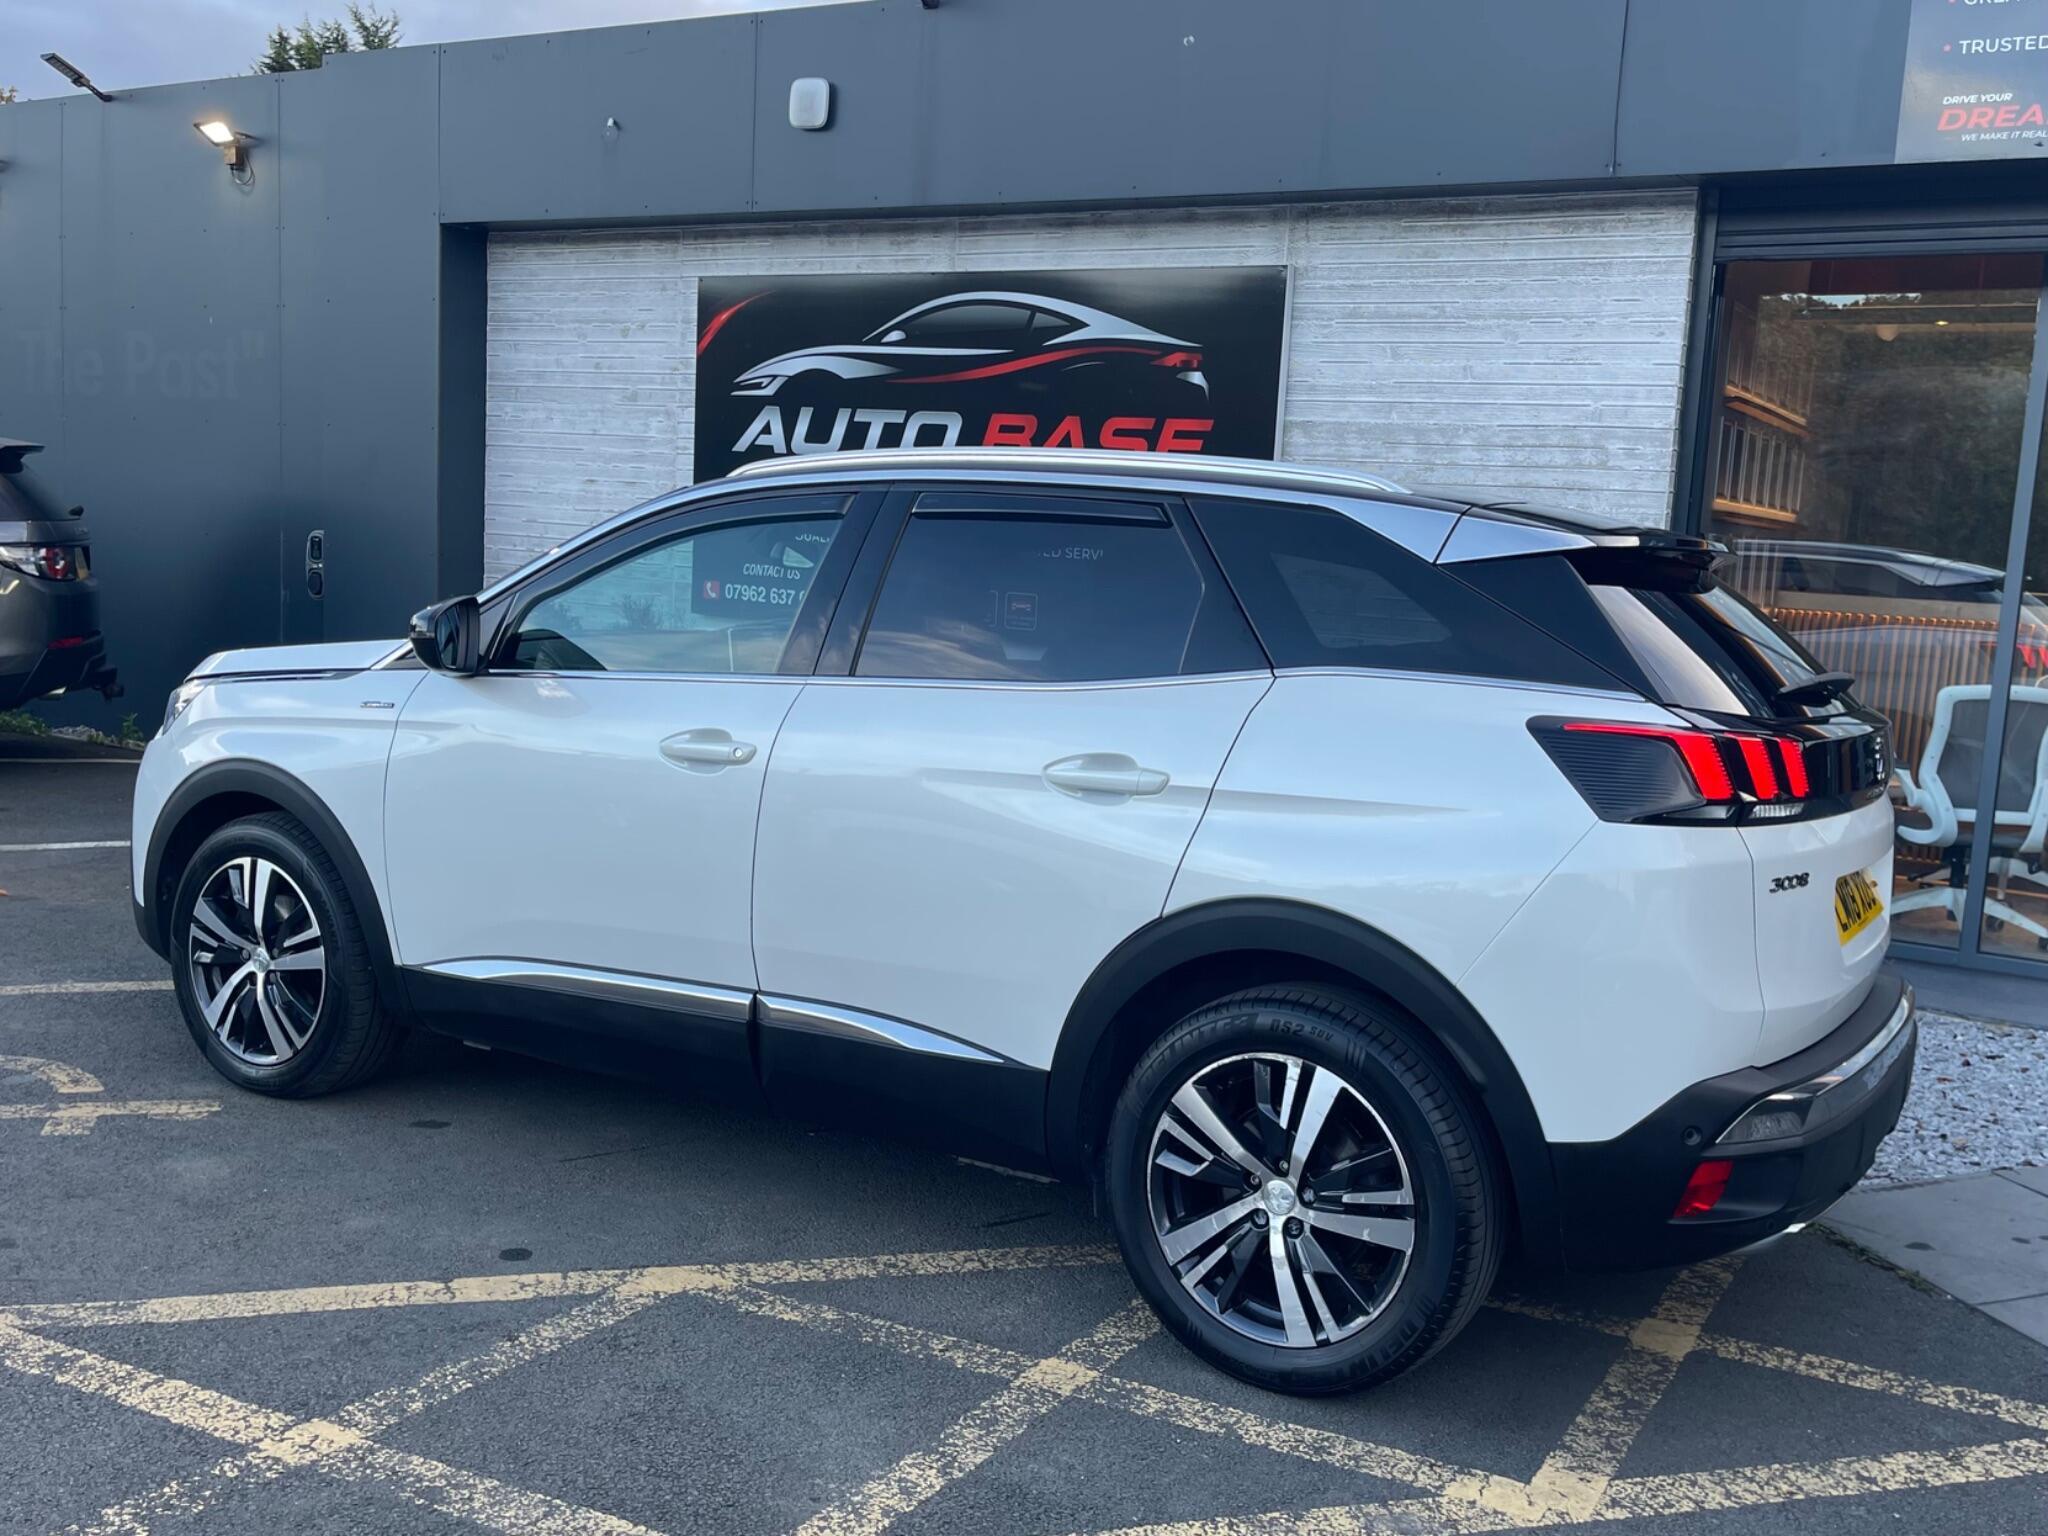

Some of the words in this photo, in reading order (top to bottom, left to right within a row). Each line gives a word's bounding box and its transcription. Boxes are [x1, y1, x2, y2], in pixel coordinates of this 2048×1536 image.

[1959, 34, 2048, 55] TRUSTED
[1942, 94, 1979, 105] DRIVE
[1980, 92, 2013, 103] YOUR
[1936, 102, 2048, 131] DREA
[1961, 132, 1978, 142] WE
[1979, 131, 2009, 141] MAKE
[2010, 131, 2021, 139] IT
[731, 404, 964, 455] AUTO
[981, 412, 1215, 454] BASE
[724, 583, 767, 603] 07962
[769, 588, 796, 605] 637
[1769, 872, 1810, 893] 3008
